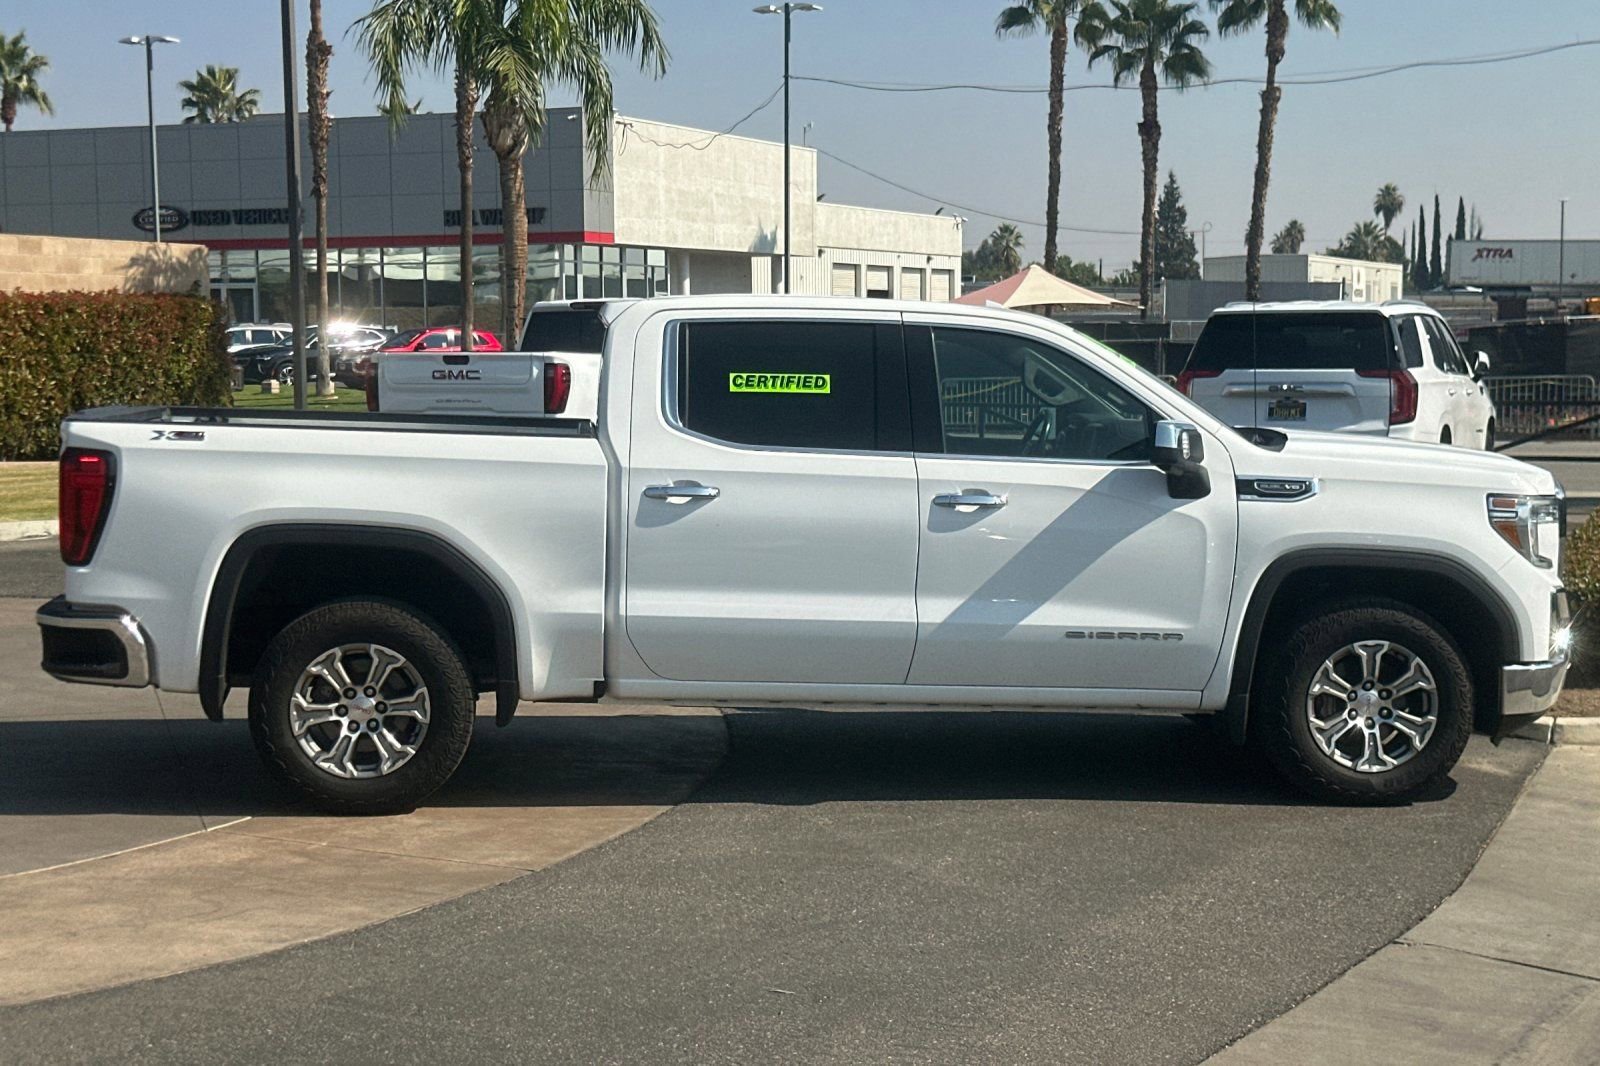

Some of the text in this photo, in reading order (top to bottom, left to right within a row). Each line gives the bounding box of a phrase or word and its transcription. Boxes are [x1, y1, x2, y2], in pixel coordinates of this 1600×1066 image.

[190, 210, 231, 226] USED
[443, 209, 479, 227] BIL
[1472, 247, 1513, 262] XTRA
[432, 369, 482, 381] GMC
[731, 374, 828, 390] CERTIFIED
[1065, 631, 1184, 641] SIERRA
